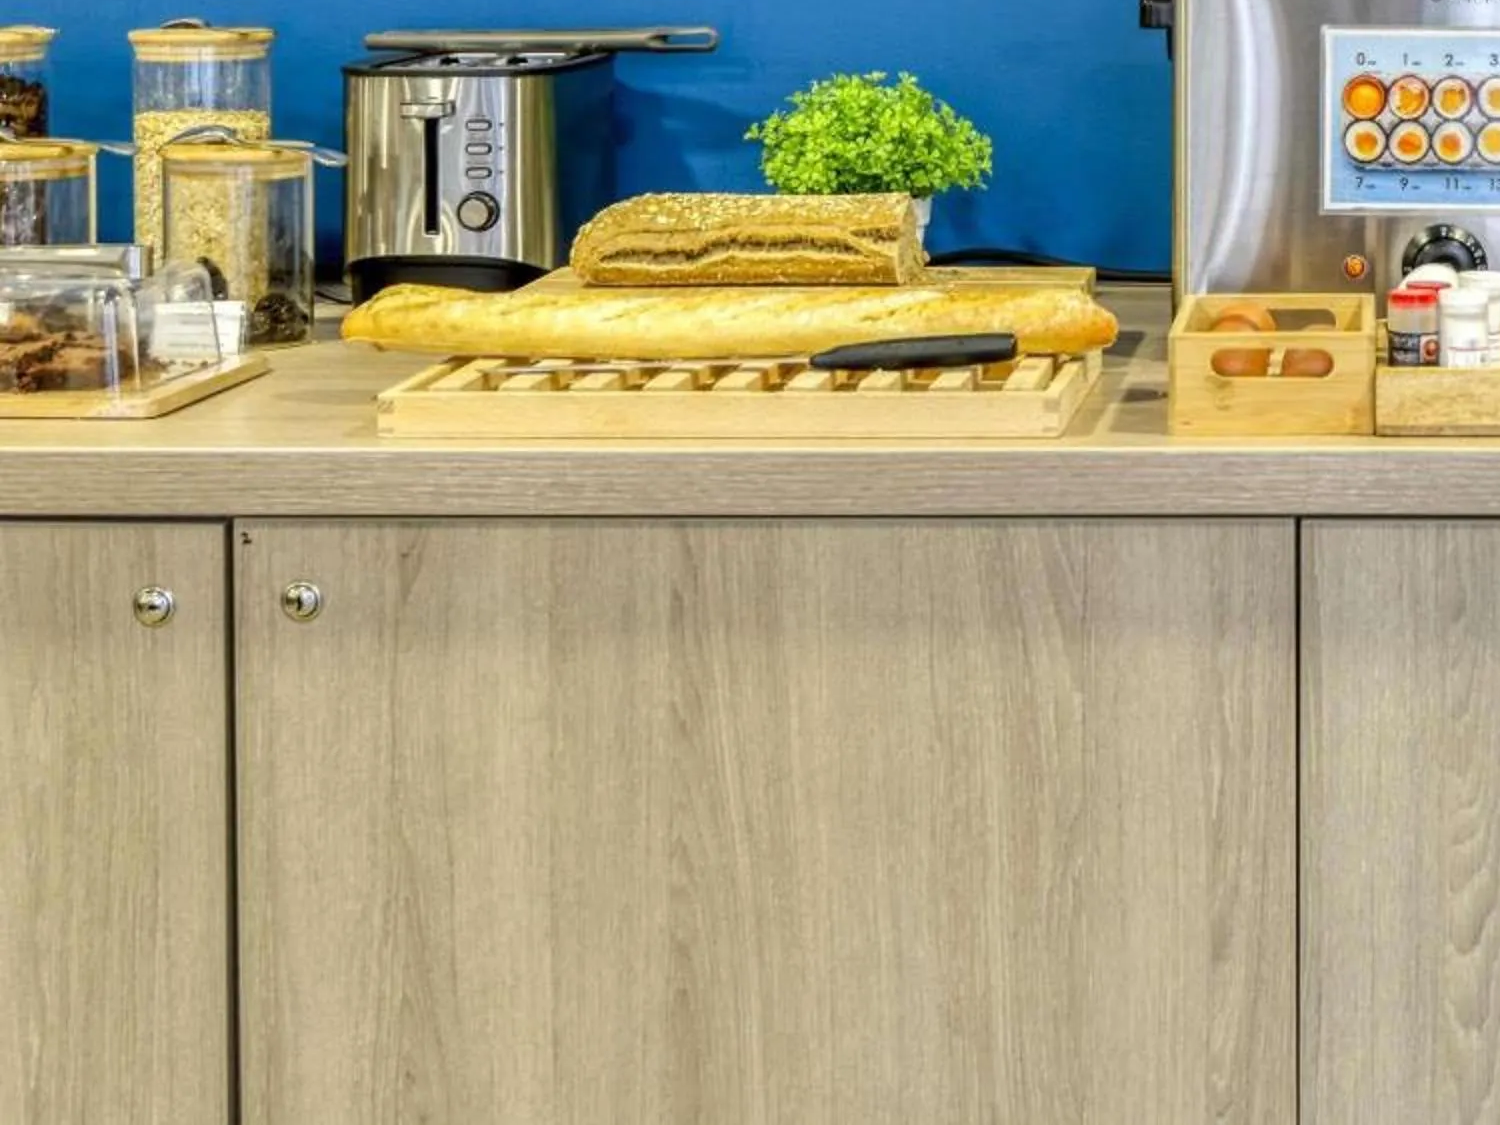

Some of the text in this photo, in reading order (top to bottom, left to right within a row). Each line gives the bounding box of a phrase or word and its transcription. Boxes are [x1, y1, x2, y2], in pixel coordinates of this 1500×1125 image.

[1356, 52, 1366, 66] 0
[1402, 53, 1409, 66] 1
[1445, 54, 1454, 67] 2
[1489, 53, 1499, 67] 3
[1355, 177, 1364, 189] 7
[1400, 177, 1409, 191] 9
[1445, 177, 1459, 190] 11
